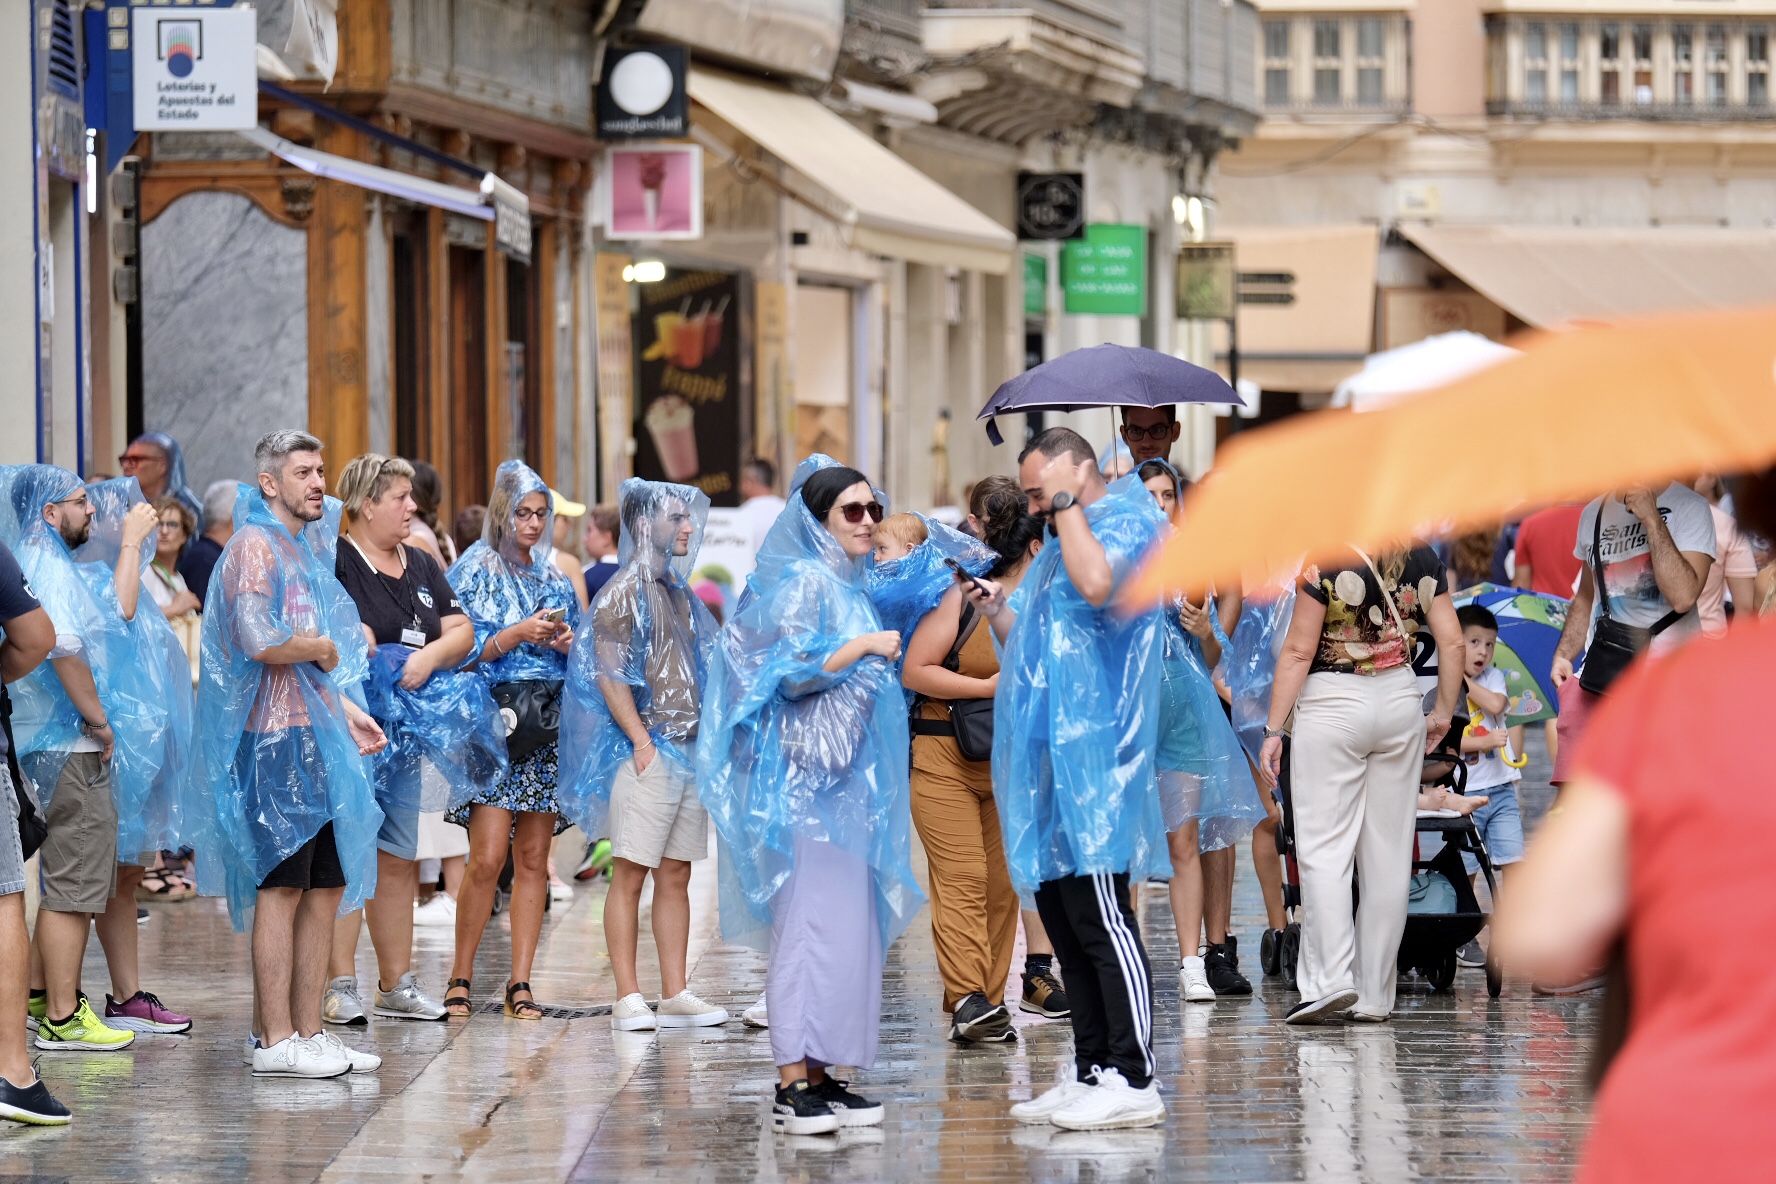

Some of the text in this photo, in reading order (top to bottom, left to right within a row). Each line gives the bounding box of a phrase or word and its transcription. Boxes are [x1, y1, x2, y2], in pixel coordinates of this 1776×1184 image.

[209, 84, 216, 94] y
[159, 94, 235, 107] Apuestas del
[158, 108, 199, 119] Estado
[1602, 522, 1642, 541] San
